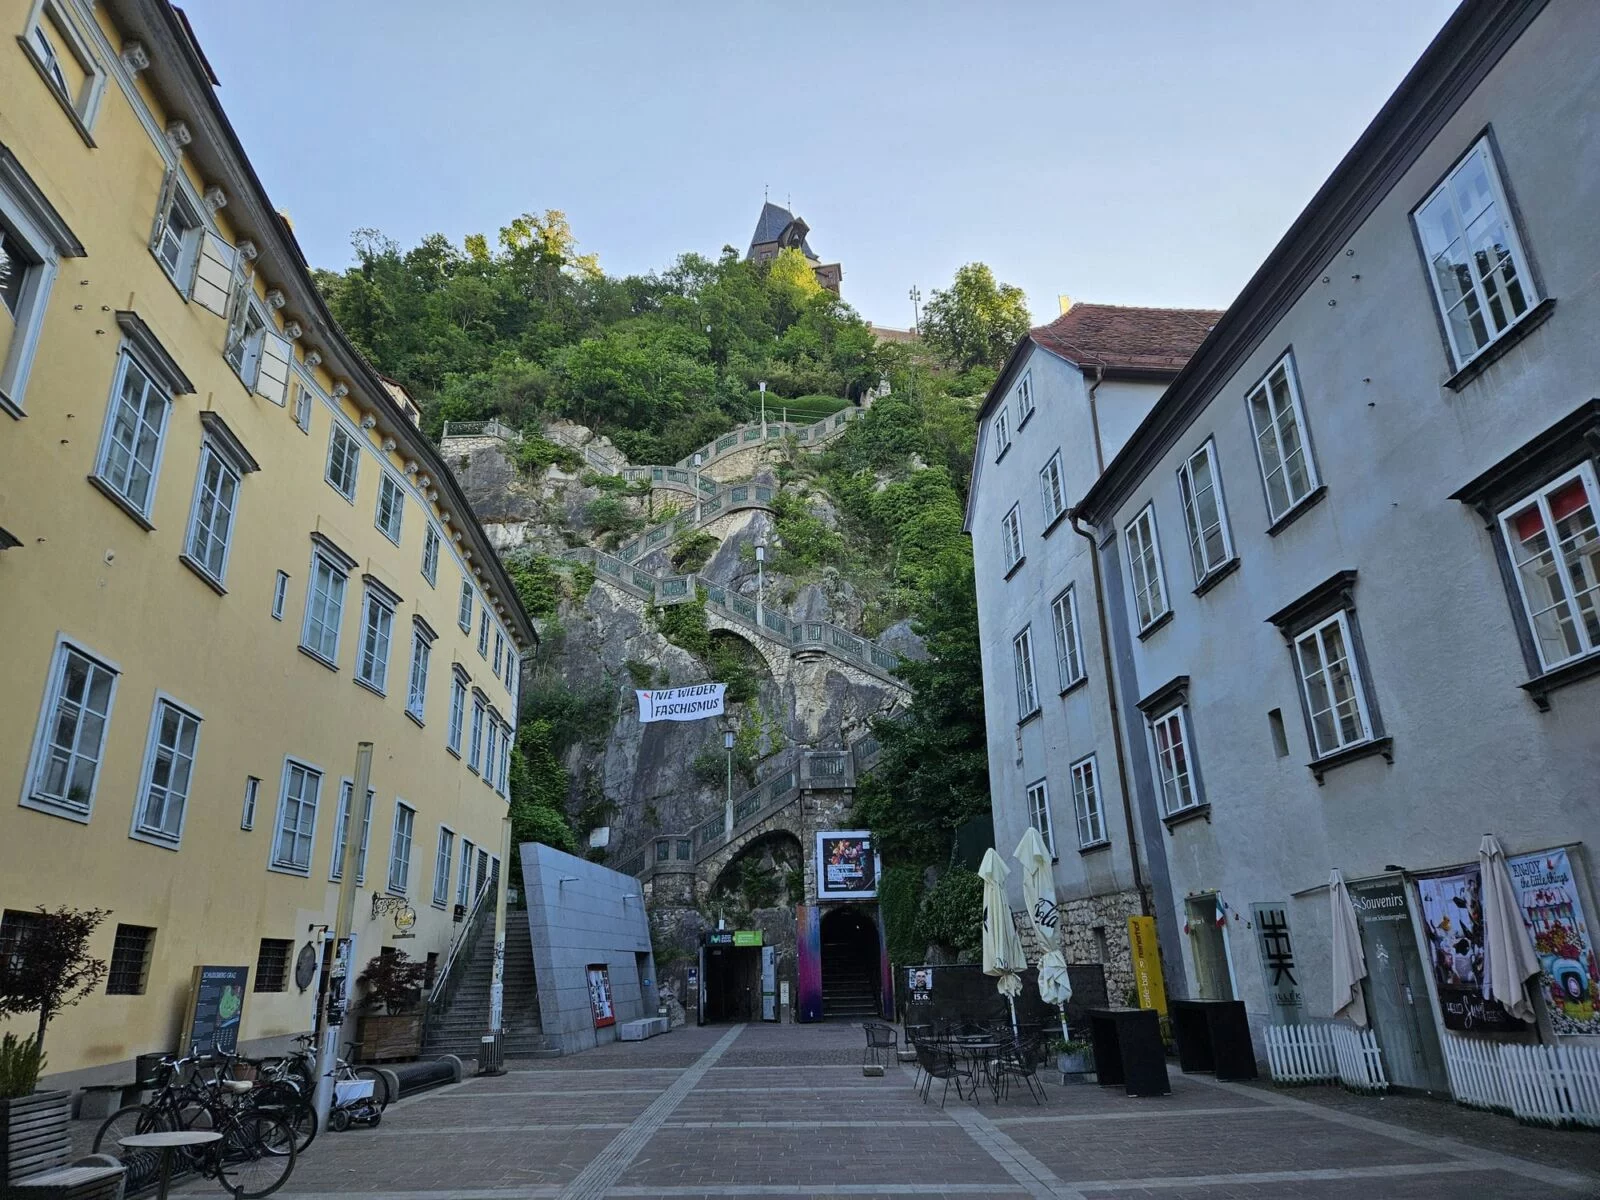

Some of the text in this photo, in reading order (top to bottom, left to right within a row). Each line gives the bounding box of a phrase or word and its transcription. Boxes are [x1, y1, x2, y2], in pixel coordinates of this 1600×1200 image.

[655, 685, 717, 700] NIE WIEDER
[655, 699, 720, 716] FASCHISMUS
[1512, 861, 1540, 877] ENJOY
[1361, 892, 1404, 910] Souvenirs
